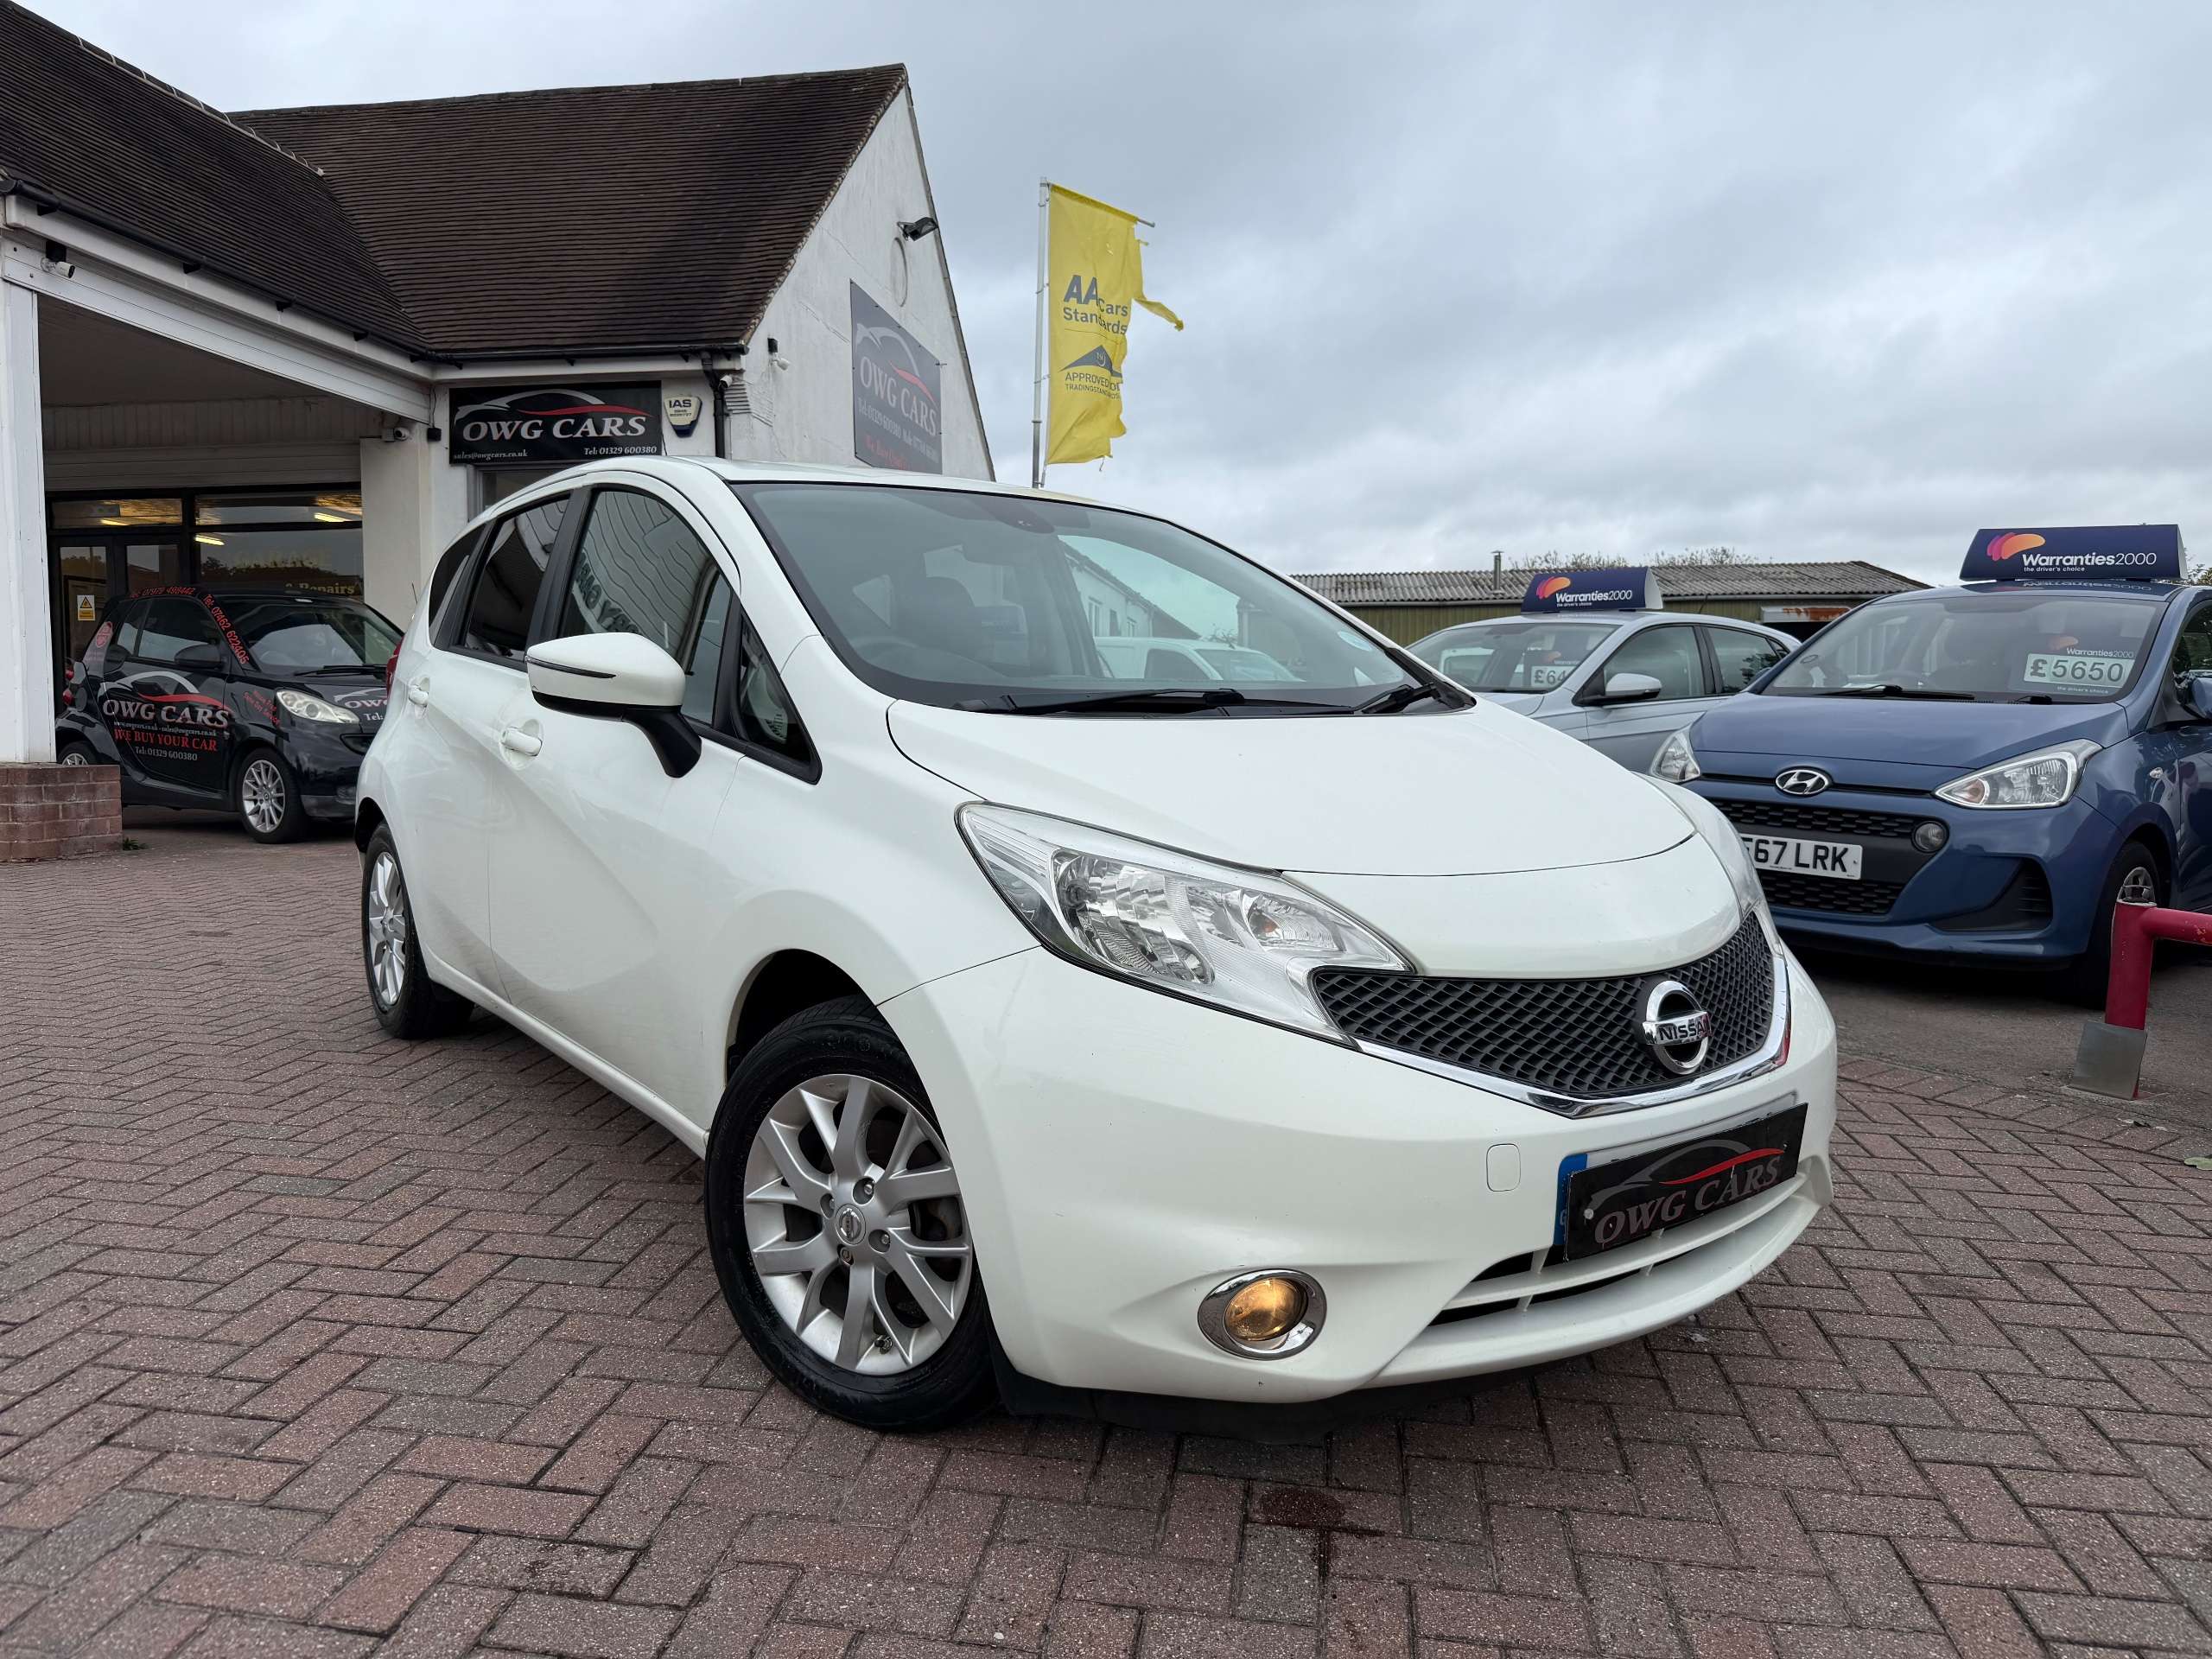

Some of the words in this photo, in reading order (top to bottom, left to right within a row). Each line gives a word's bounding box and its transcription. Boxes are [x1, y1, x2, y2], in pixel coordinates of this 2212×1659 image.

[1064, 274, 1098, 306] AA
[1098, 298, 1128, 317] Cars
[1064, 307, 1128, 335] Standards
[1065, 372, 1109, 388] APPROVED
[669, 399, 692, 409] IAS
[860, 356, 897, 408] OWG
[900, 388, 937, 436] CARS
[462, 419, 543, 442] OWG
[552, 416, 646, 439] CARS
[584, 447, 598, 455] Tel:
[624, 446, 658, 454] 600380
[2022, 551, 2158, 567] Warranties2000
[1555, 589, 1632, 603] Warranties2000
[2066, 647, 2135, 658] Warranties2000
[2030, 658, 2124, 682] £5650
[102, 699, 156, 721] OWG
[161, 705, 230, 729] CARS
[363, 712, 384, 721] Tel:
[114, 728, 132, 741] WE
[134, 731, 157, 745] BUY
[157, 734, 189, 747] YOUR
[192, 738, 217, 751] CAR
[147, 748, 168, 758] 01329
[168, 750, 198, 761] 600380
[1794, 842, 1849, 873] LRK
[1594, 1190, 1687, 1243] OWG
[1694, 1156, 1780, 1211] CARS
